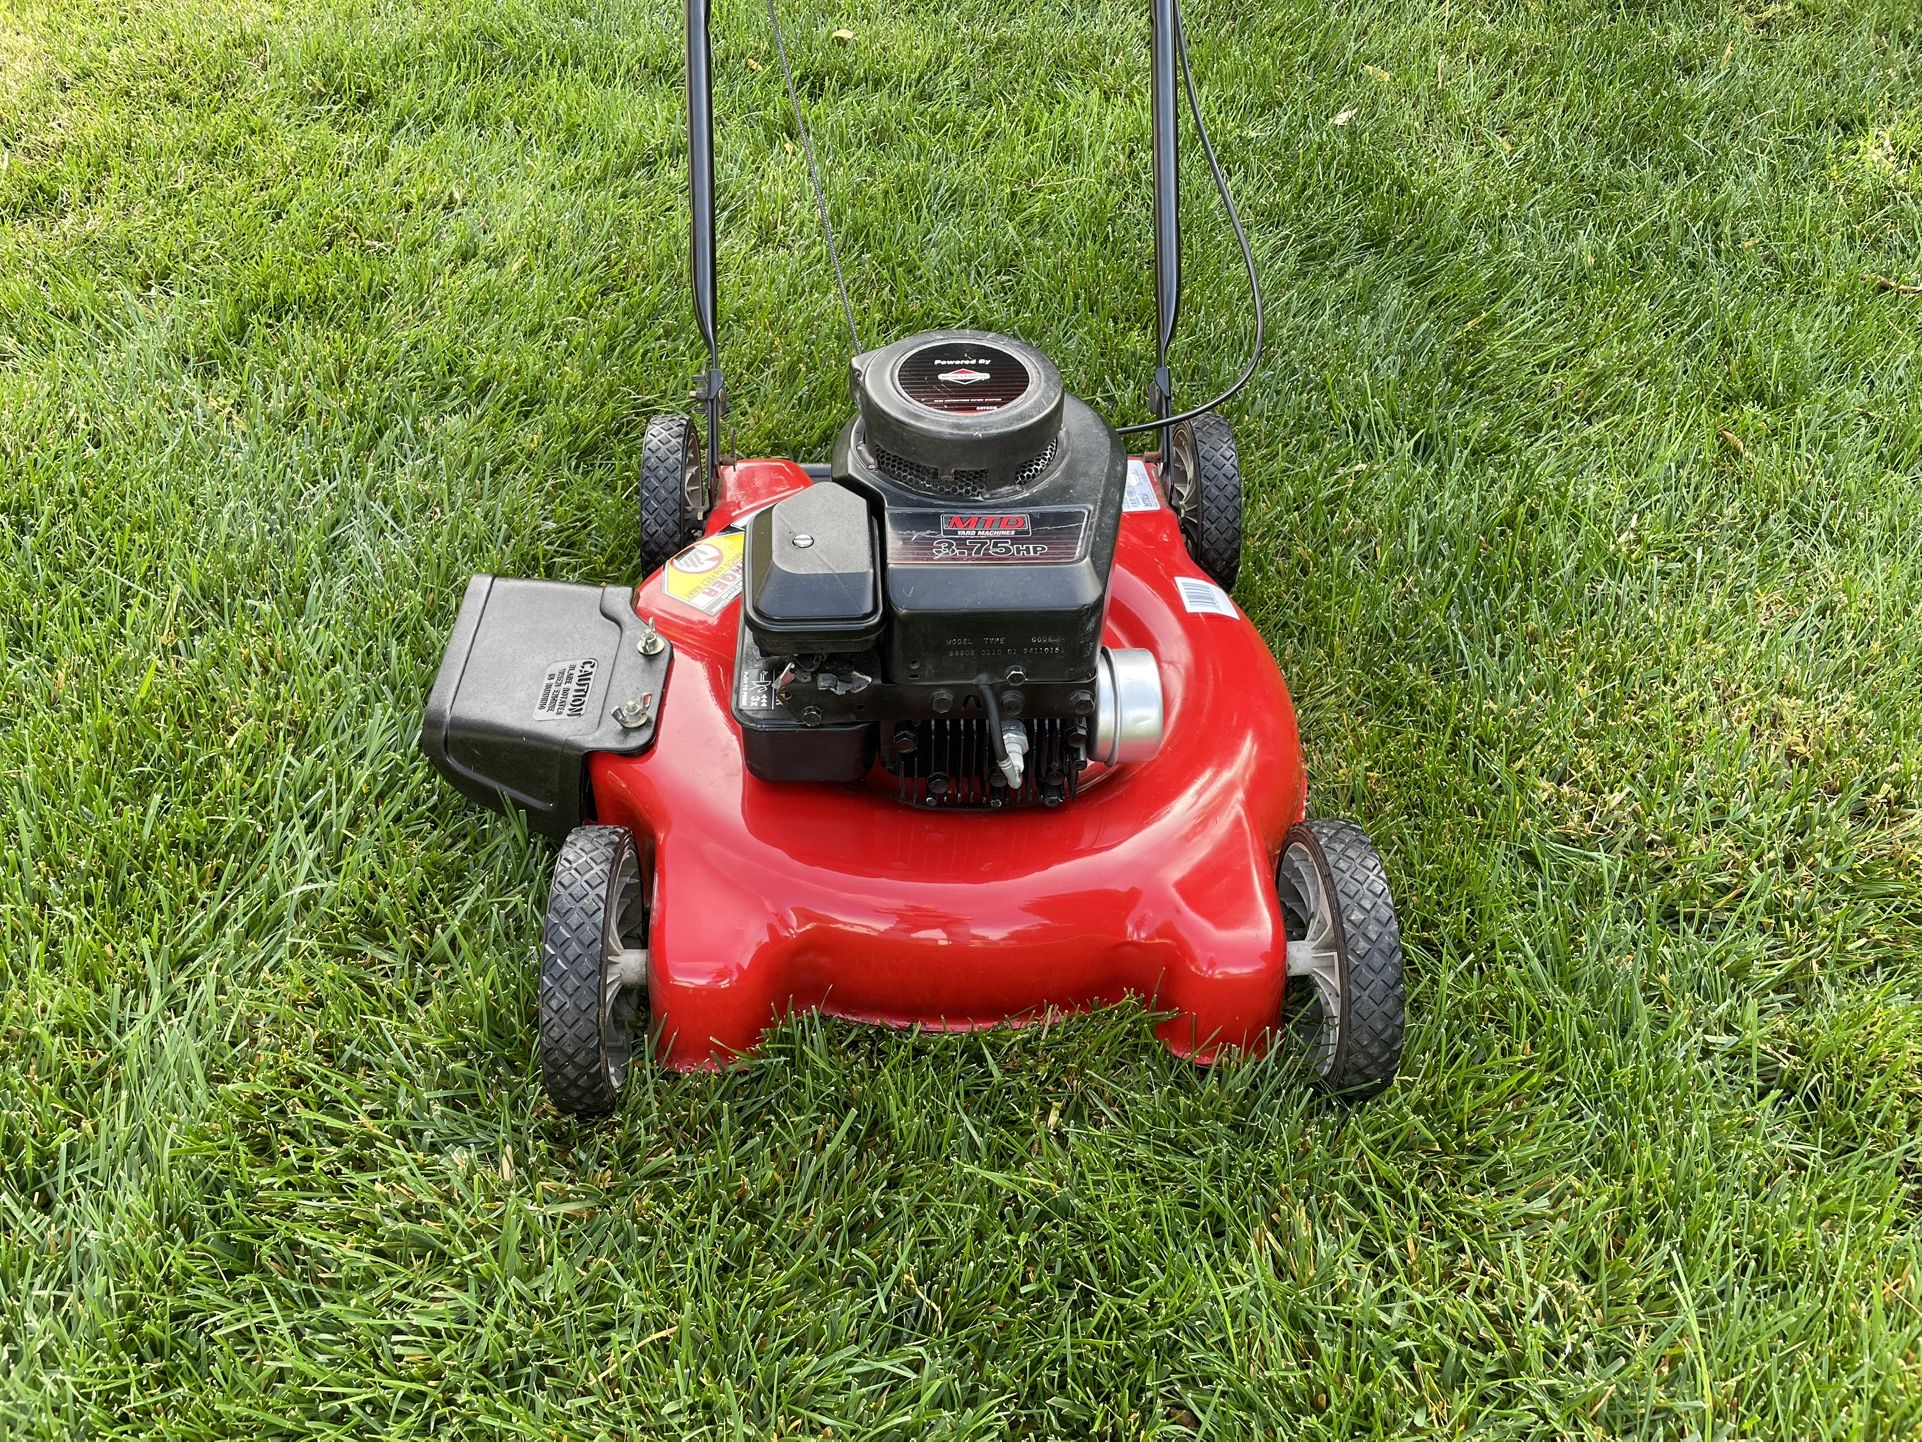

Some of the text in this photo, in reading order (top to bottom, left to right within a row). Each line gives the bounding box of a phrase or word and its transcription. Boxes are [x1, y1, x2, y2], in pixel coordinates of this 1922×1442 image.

[947, 516, 1025, 529] MTD
[702, 564, 743, 598] NGER
[555, 687, 571, 715] ROTATES
[566, 660, 596, 717] CAUTION
